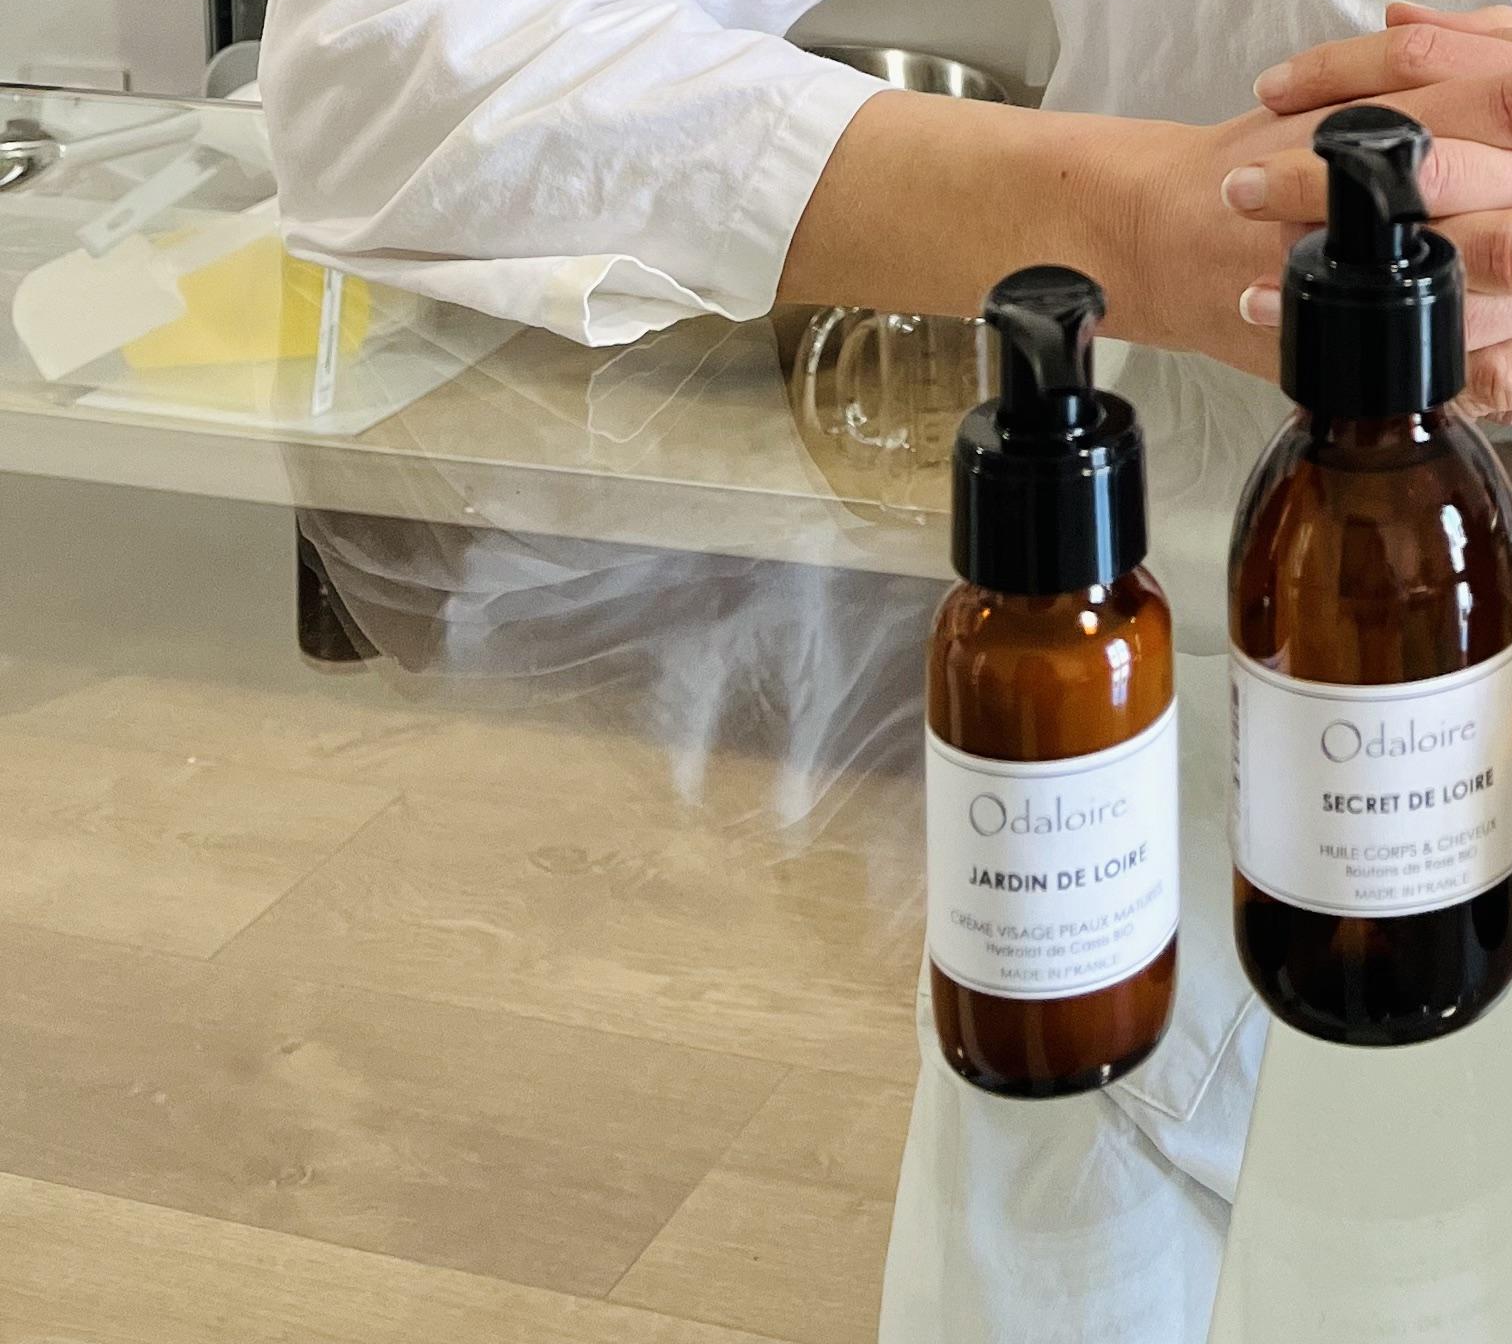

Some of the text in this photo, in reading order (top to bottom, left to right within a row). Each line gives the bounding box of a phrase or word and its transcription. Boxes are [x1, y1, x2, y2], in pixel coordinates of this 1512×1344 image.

[1320, 718, 1477, 763] Odaloire
[1322, 766, 1495, 814] SECRET DE LOIRE
[969, 791, 1129, 837] Odaloire
[1319, 817, 1497, 861] HUILE CORPS & CHEVEUX
[968, 840, 1148, 892] JARDIN DE LOIRE
[1345, 864, 1399, 879] Boutons
[1403, 862, 1420, 875] de
[1425, 856, 1454, 871] Rose
[1354, 872, 1472, 901] MADE IN FRANCE
[999, 924, 1054, 942] VISAGE
[1059, 916, 1109, 939] PEAUX
[986, 941, 1042, 959] Hydrolat
[1046, 943, 1066, 957] de
[1001, 955, 1119, 981] MADE IN FRANCE
